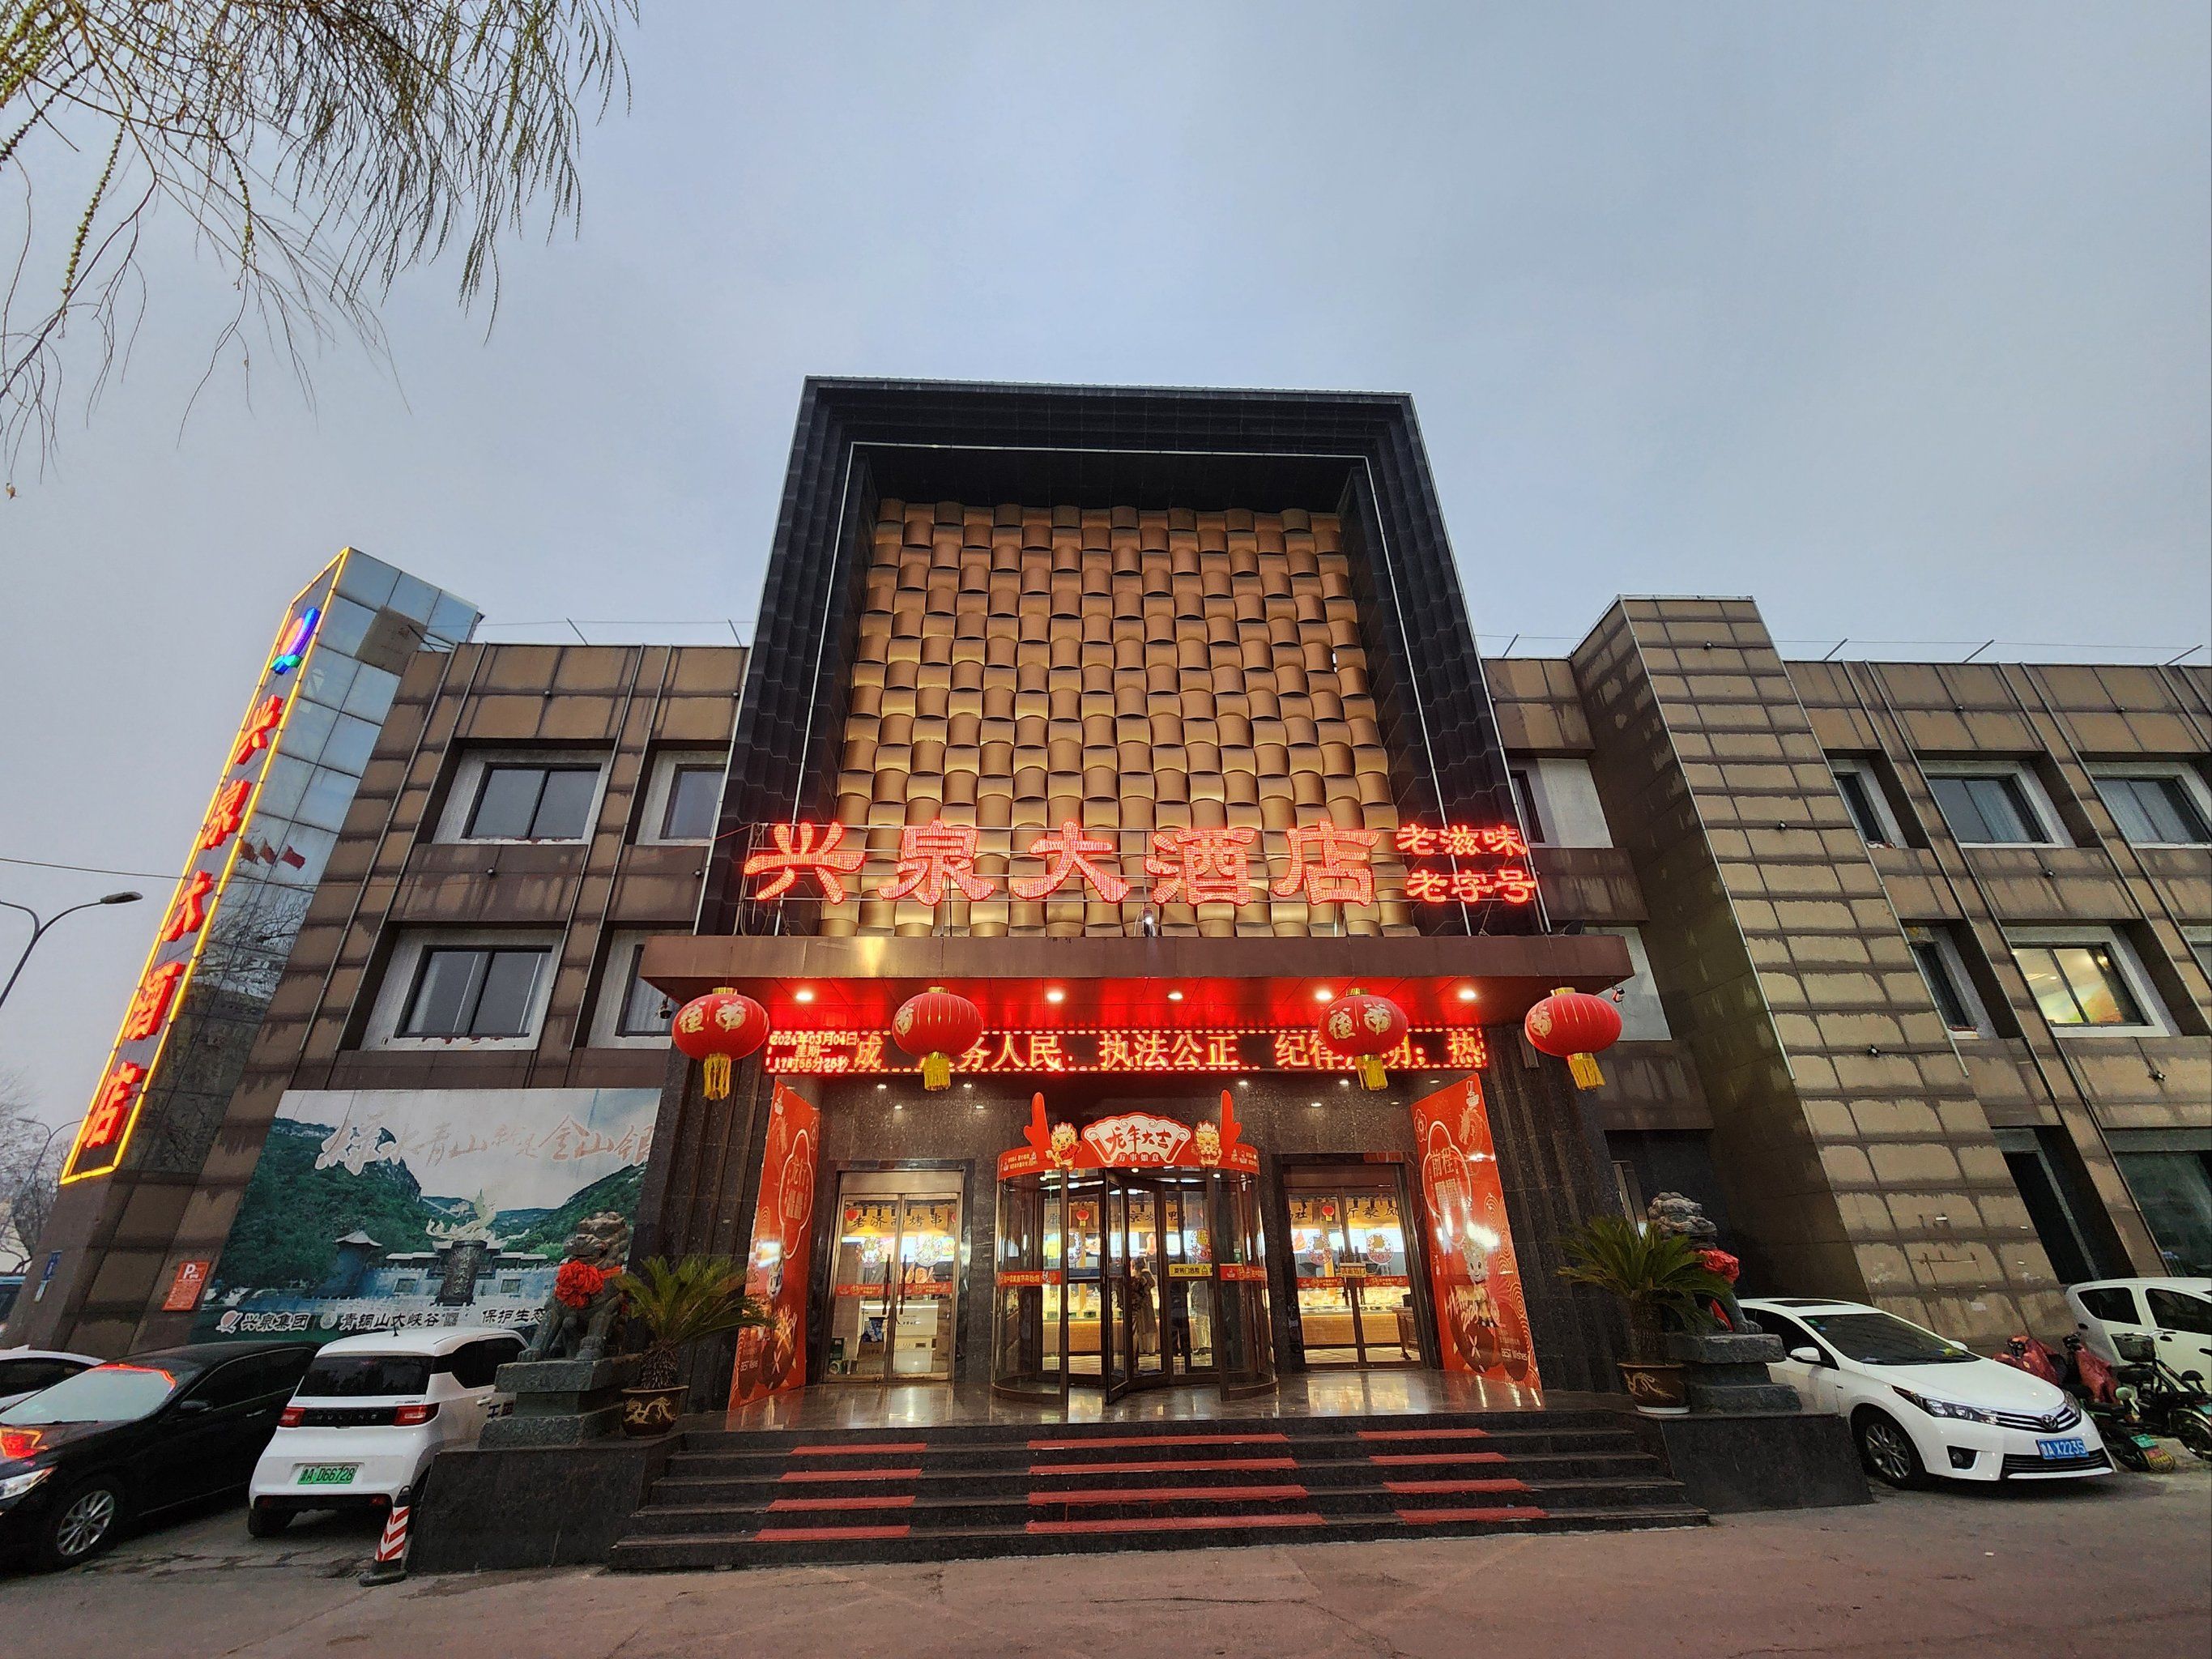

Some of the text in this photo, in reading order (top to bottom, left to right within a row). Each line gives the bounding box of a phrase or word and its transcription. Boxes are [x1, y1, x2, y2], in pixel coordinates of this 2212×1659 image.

[1395, 821, 1528, 857] 老滋味
[743, 820, 1380, 906] 兴泉大酒店
[1404, 868, 1537, 903] 老字号
[80, 694, 283, 1149] 兴泉大酒店
[794, 1045, 831, 1058] 星期一
[1098, 1034, 1240, 1068] 执法公正
[1447, 1030, 1481, 1064] 热
[1104, 1124, 1173, 1154] 龙年大吉
[1118, 1153, 1160, 1162] 万事如意
[241, 1312, 311, 1333] 兴泉集团
[339, 1311, 441, 1332] 青铜山大峡谷
